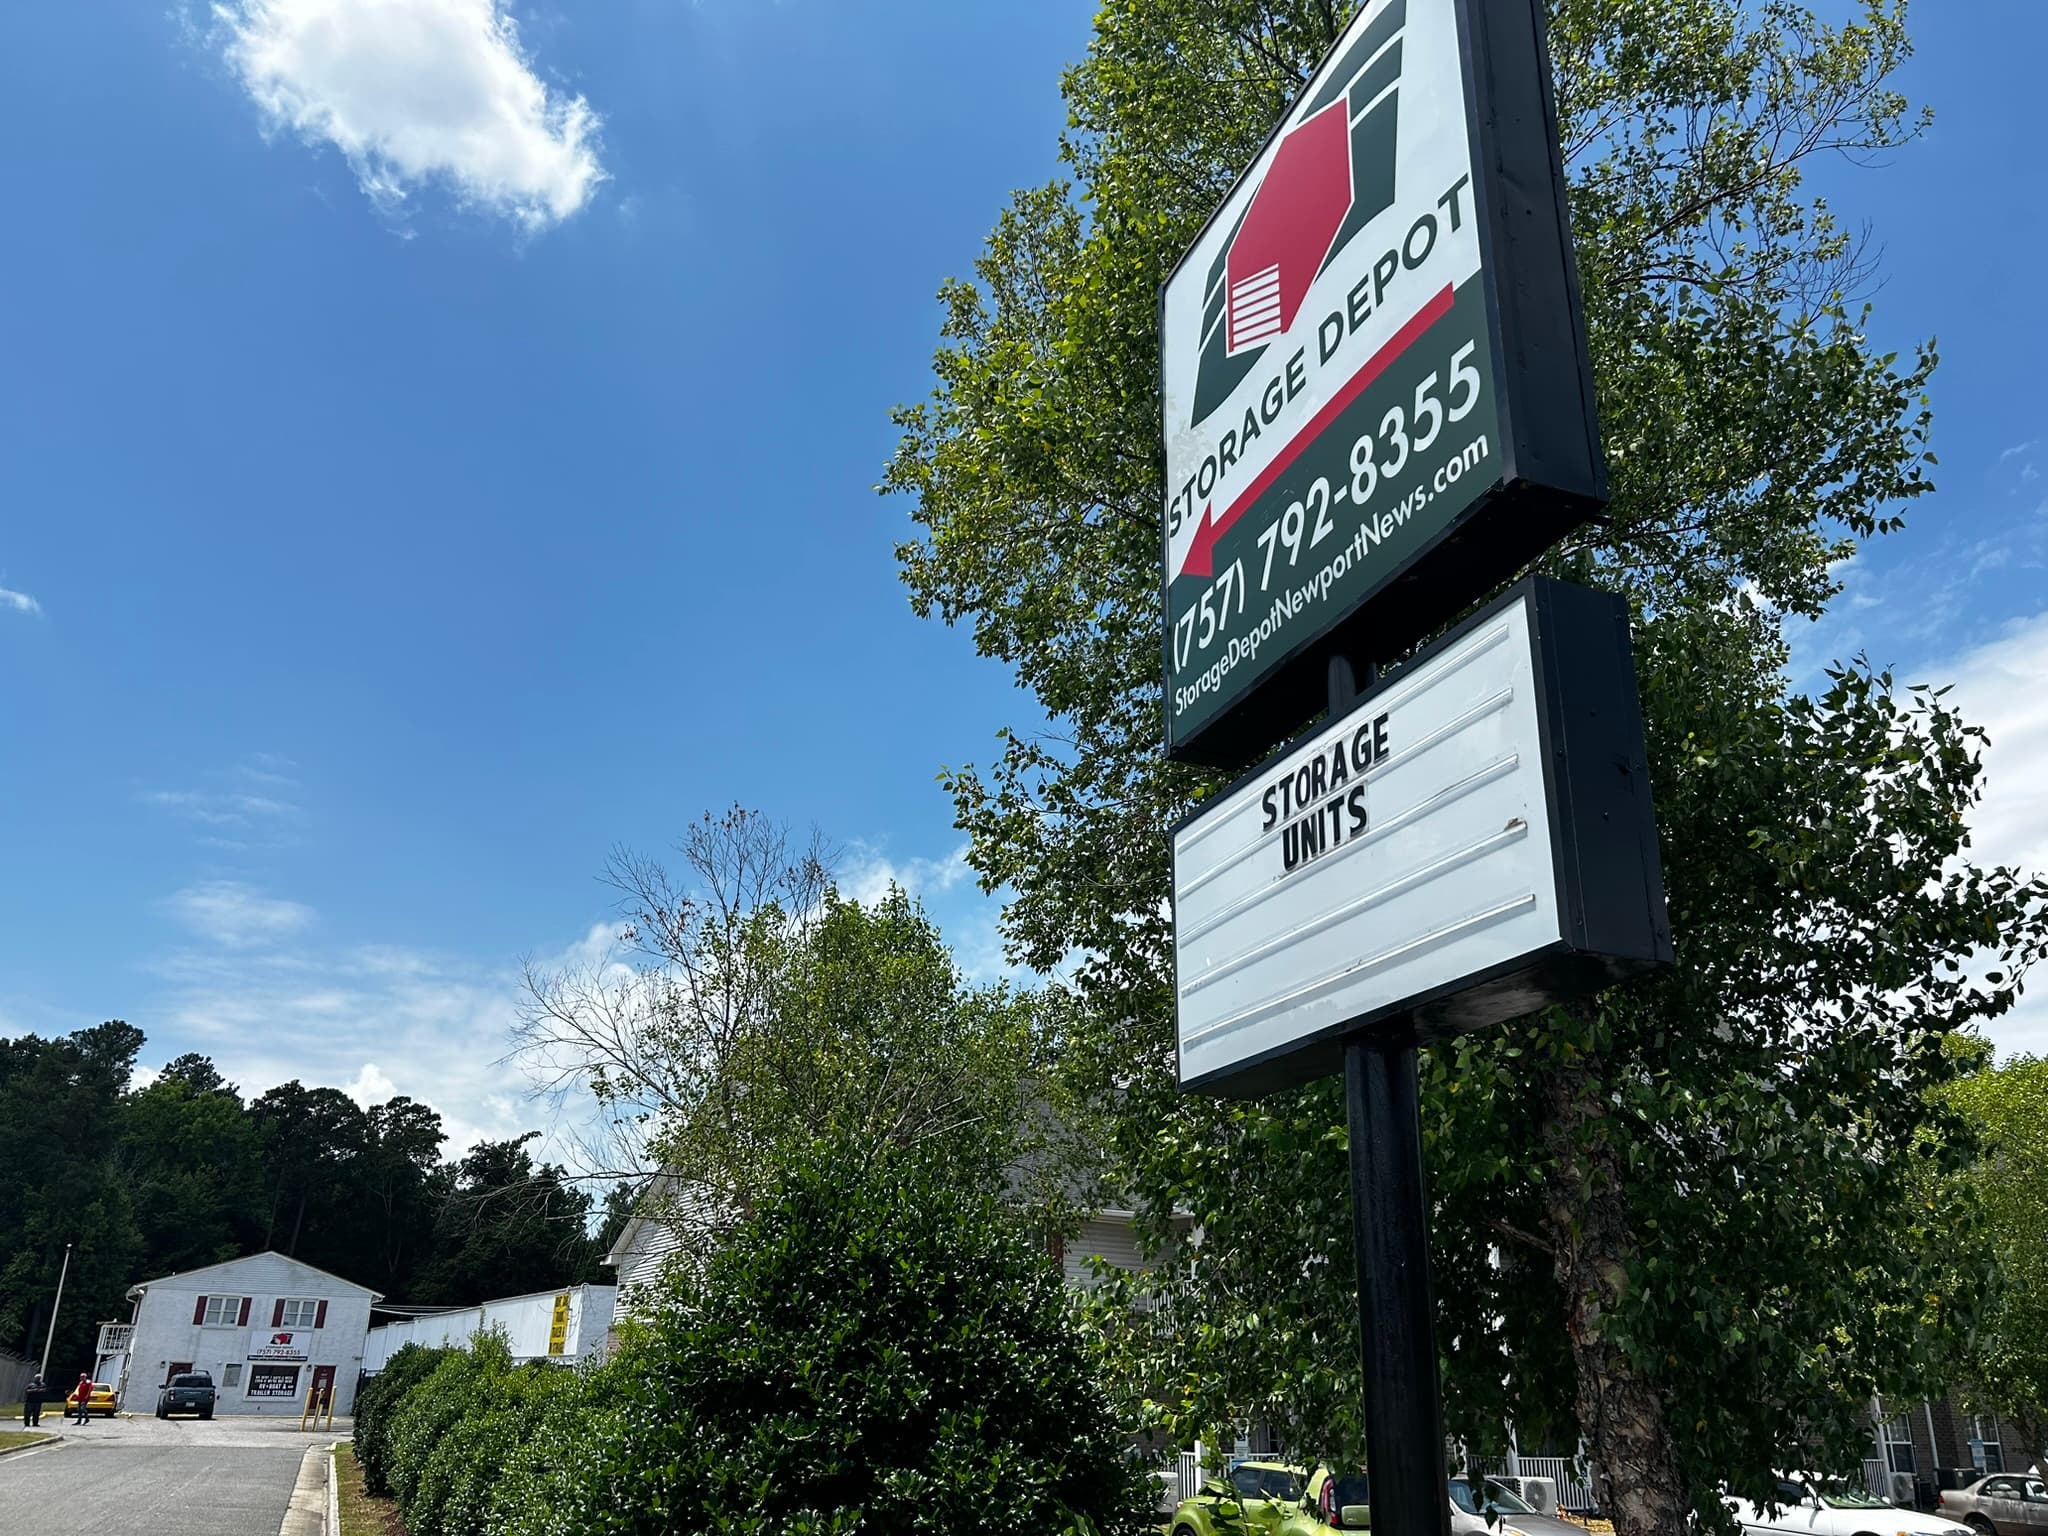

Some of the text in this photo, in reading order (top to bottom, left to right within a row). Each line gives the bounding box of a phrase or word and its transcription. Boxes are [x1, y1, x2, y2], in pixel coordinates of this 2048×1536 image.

[1169, 172, 1470, 539] STORAGE DEPOT
[1173, 338, 1481, 676] (757) 792-8355
[1175, 433, 1489, 717] StorageDepotNewportNews.com
[1261, 711, 1390, 832] STORAGE
[1282, 784, 1368, 872] UNITS
